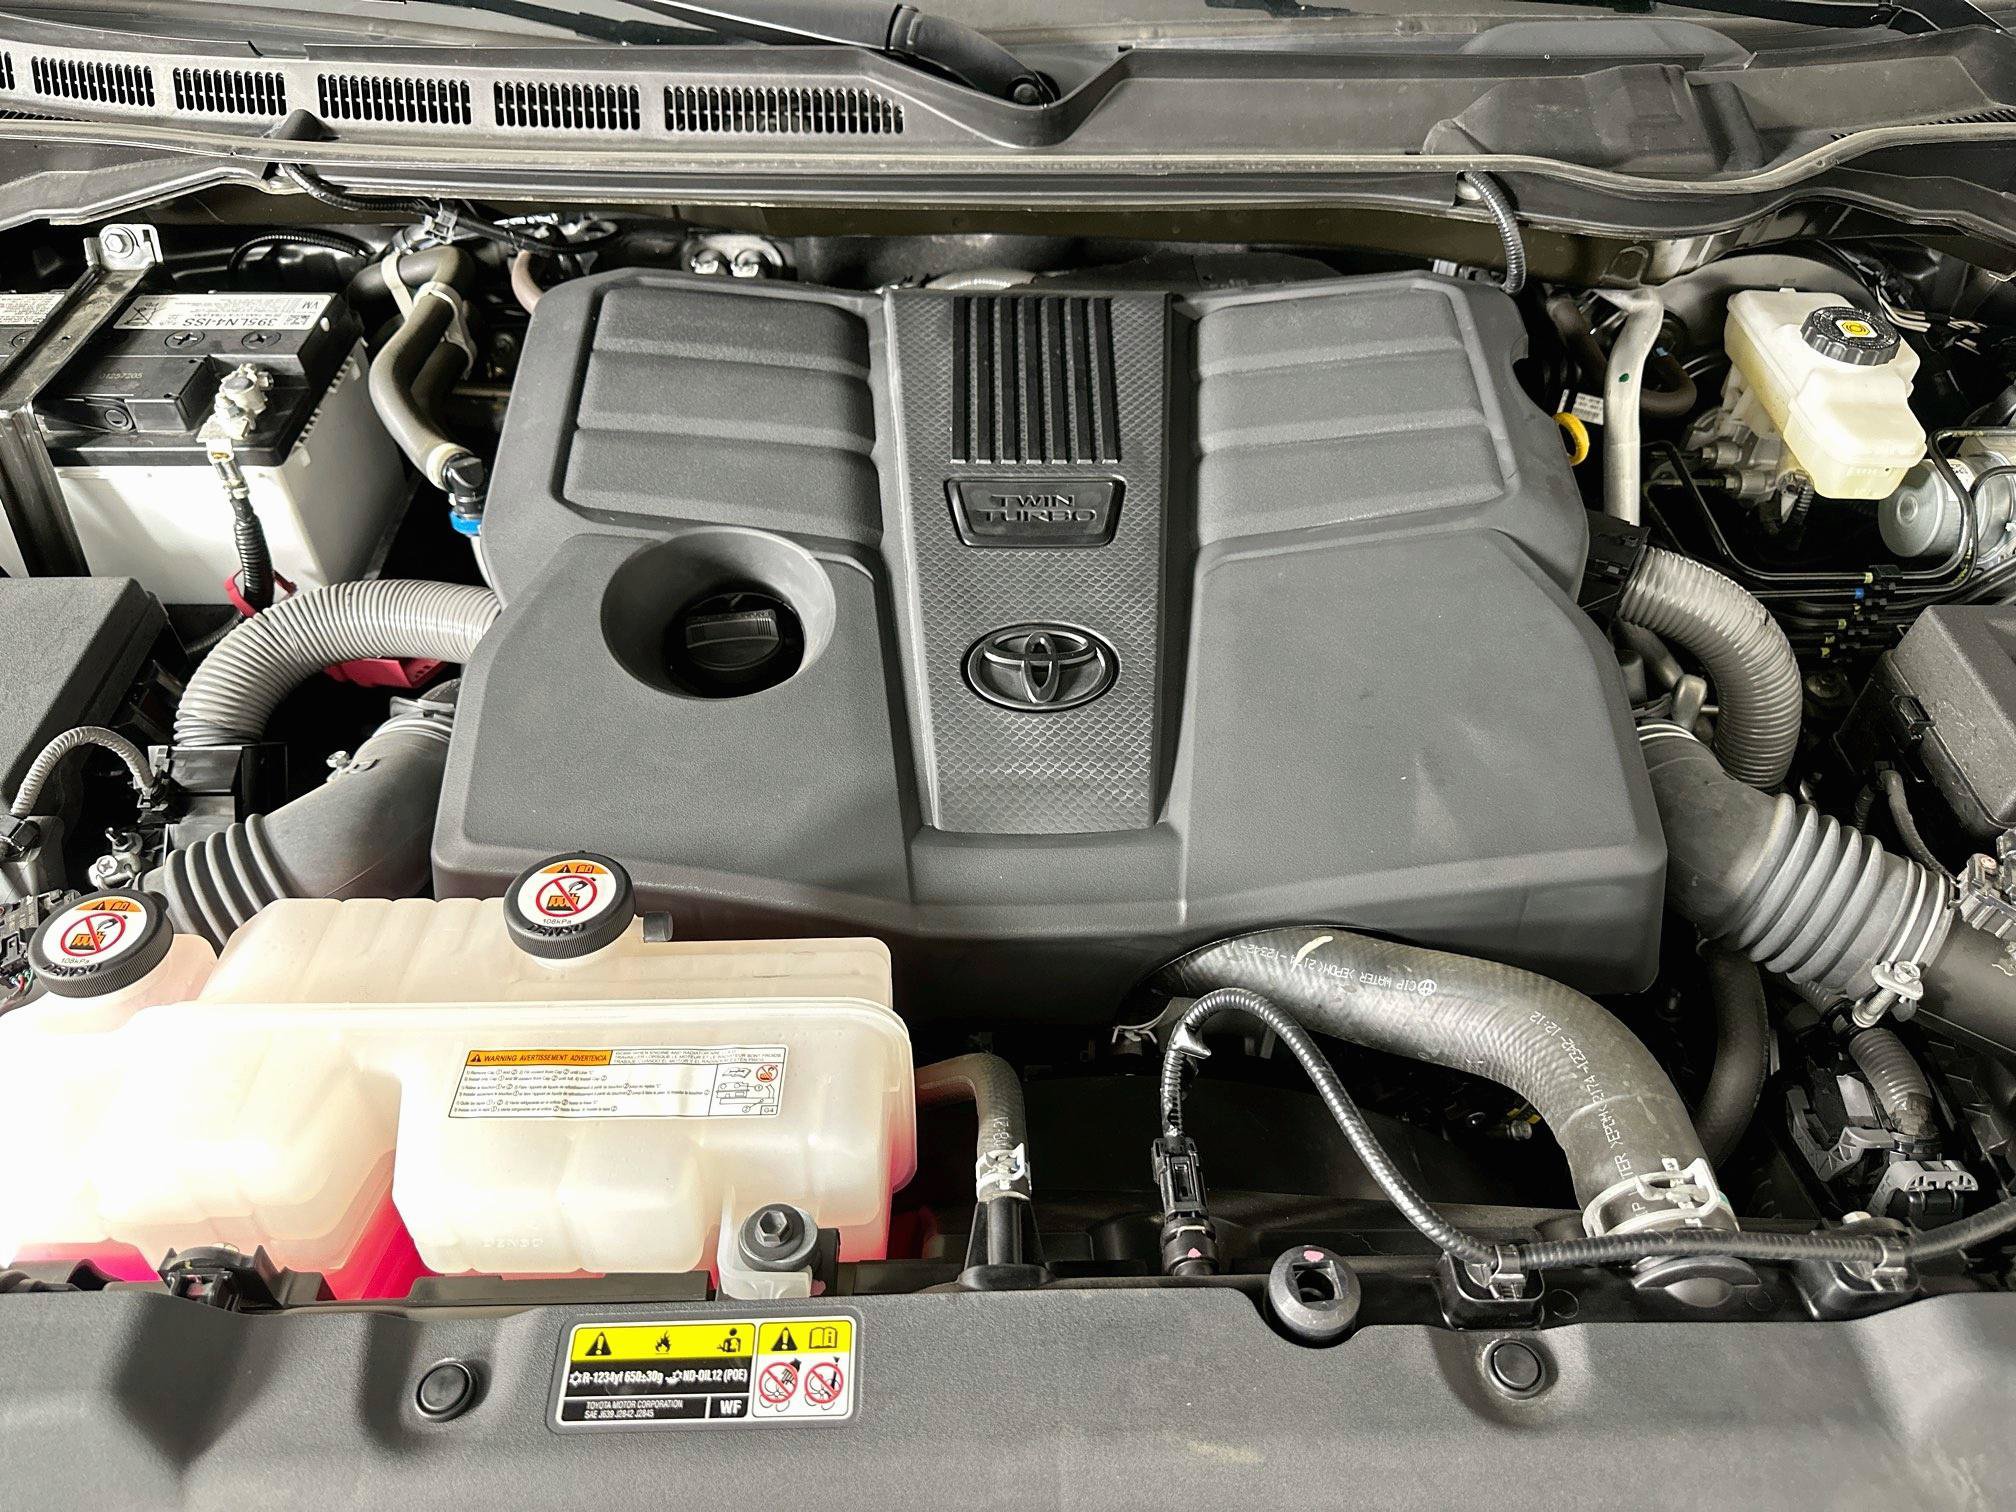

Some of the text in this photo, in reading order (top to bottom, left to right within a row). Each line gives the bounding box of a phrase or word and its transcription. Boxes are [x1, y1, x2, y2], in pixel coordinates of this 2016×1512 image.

[991, 494, 1075, 507] TWIN
[972, 509, 1097, 522] TURBO
[526, 924, 585, 936] DENSO
[42, 964, 101, 977] DENSO
[1359, 972, 1392, 988] WATER
[484, 1054, 517, 1062] WARNING
[519, 1054, 568, 1062] AVERTISSEMENT
[570, 1054, 607, 1062] ADVERTENCIA
[582, 1371, 663, 1386] R-1234yf 650±30g
[723, 1369, 747, 1382] (POE)
[586, 1399, 684, 1410] TOYOTA MOTOR CORPORATION
[719, 1400, 742, 1414] WF
[584, 1410, 598, 1419] SAE
